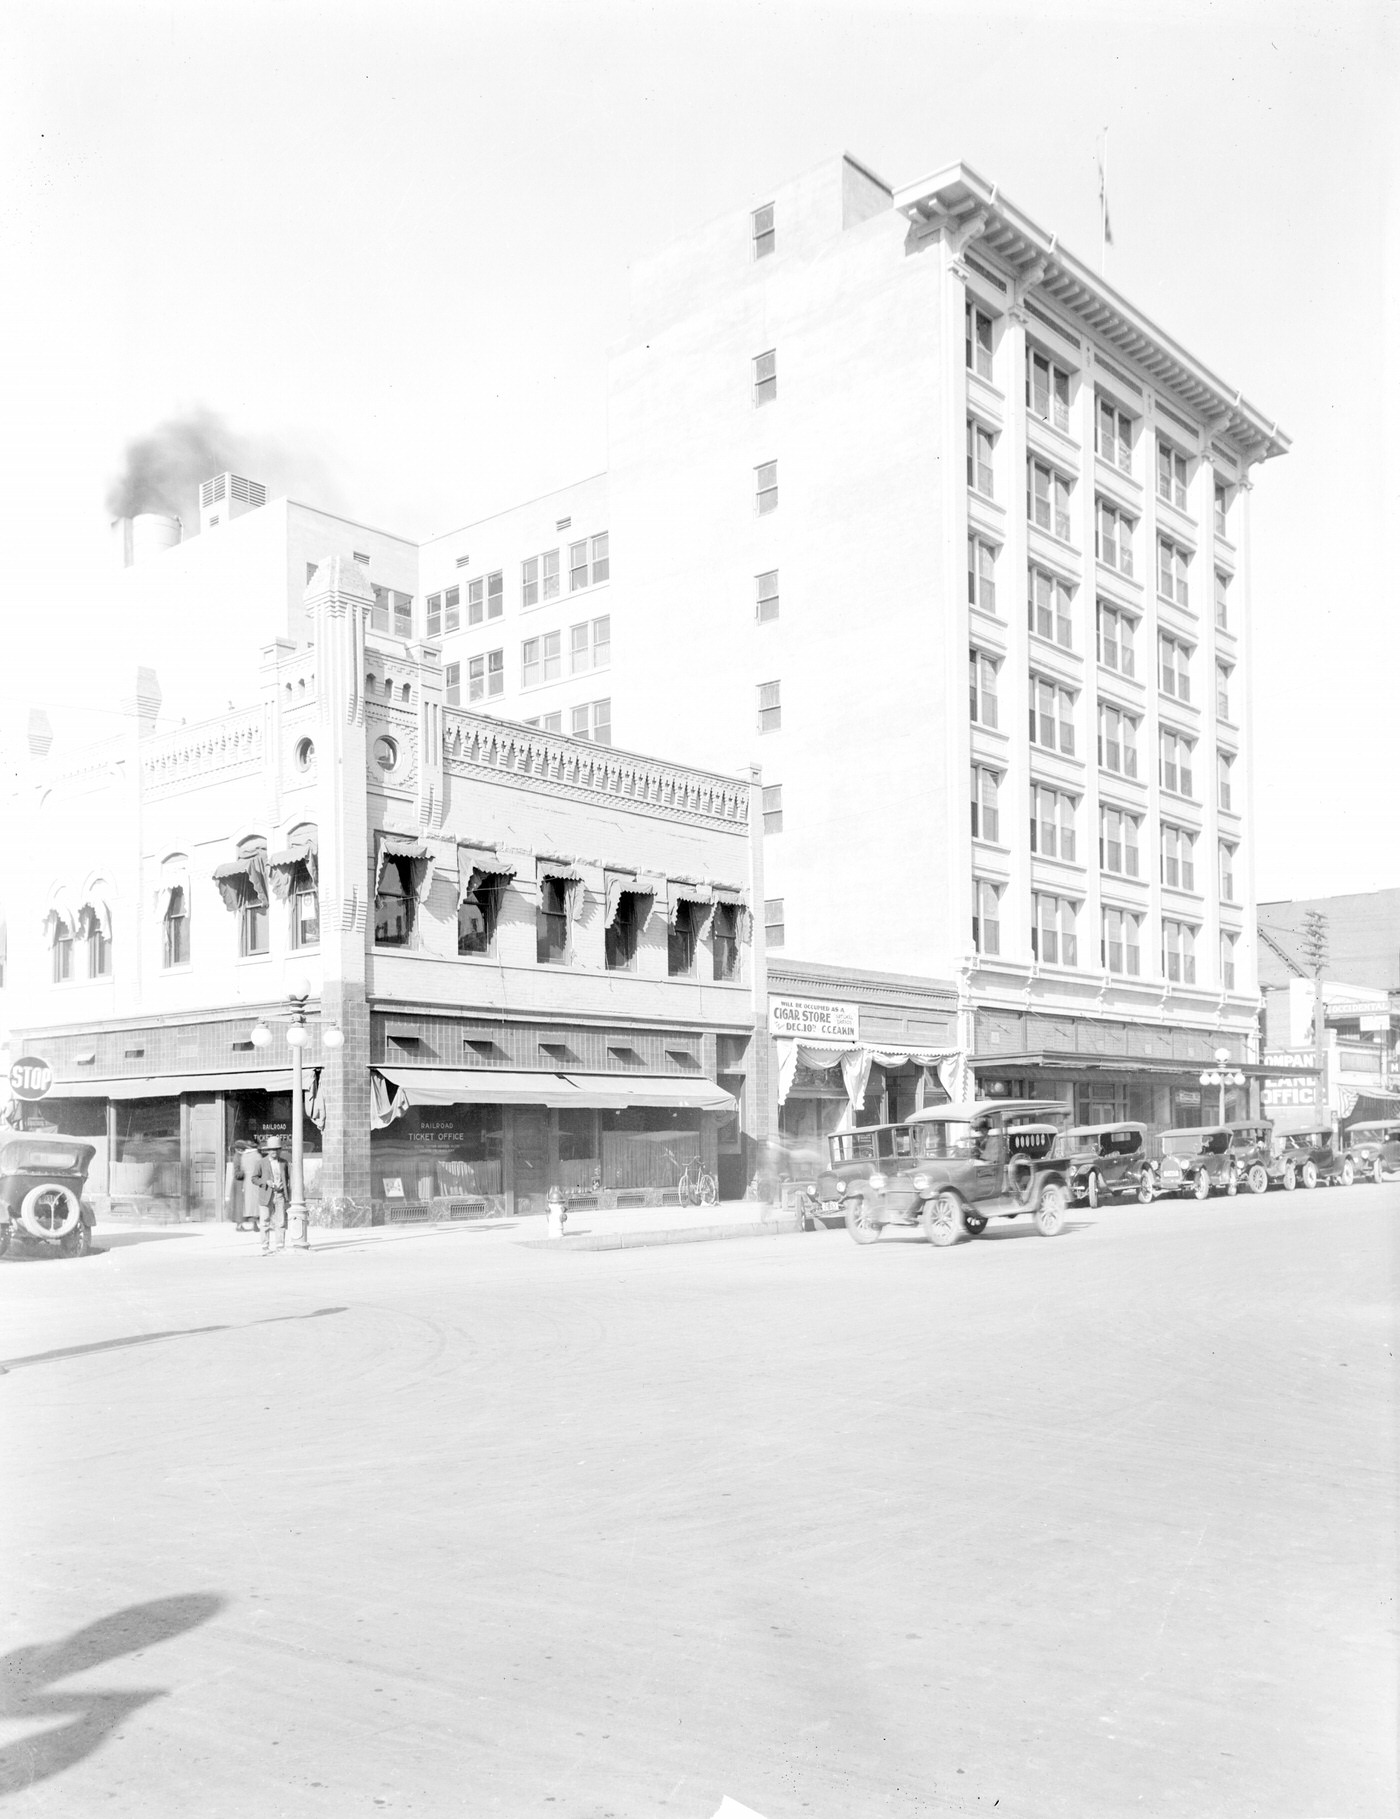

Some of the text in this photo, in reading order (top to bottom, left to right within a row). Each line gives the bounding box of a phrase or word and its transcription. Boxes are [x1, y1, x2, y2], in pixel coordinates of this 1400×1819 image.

[804, 1004, 830, 1012] OCCUPIED
[1332, 1003, 1389, 1012] OCCIDENTAL
[773, 1007, 800, 1021] CIGAR
[802, 1010, 831, 1023] STORE
[1264, 1053, 1325, 1068] OMPAN
[11, 1064, 51, 1091] STOP
[262, 1123, 287, 1131] RAILROAD
[420, 1122, 454, 1130] RAILROAD
[276, 1133, 293, 1142] OFFIC
[408, 1132, 465, 1141] TICKET OFFICE
